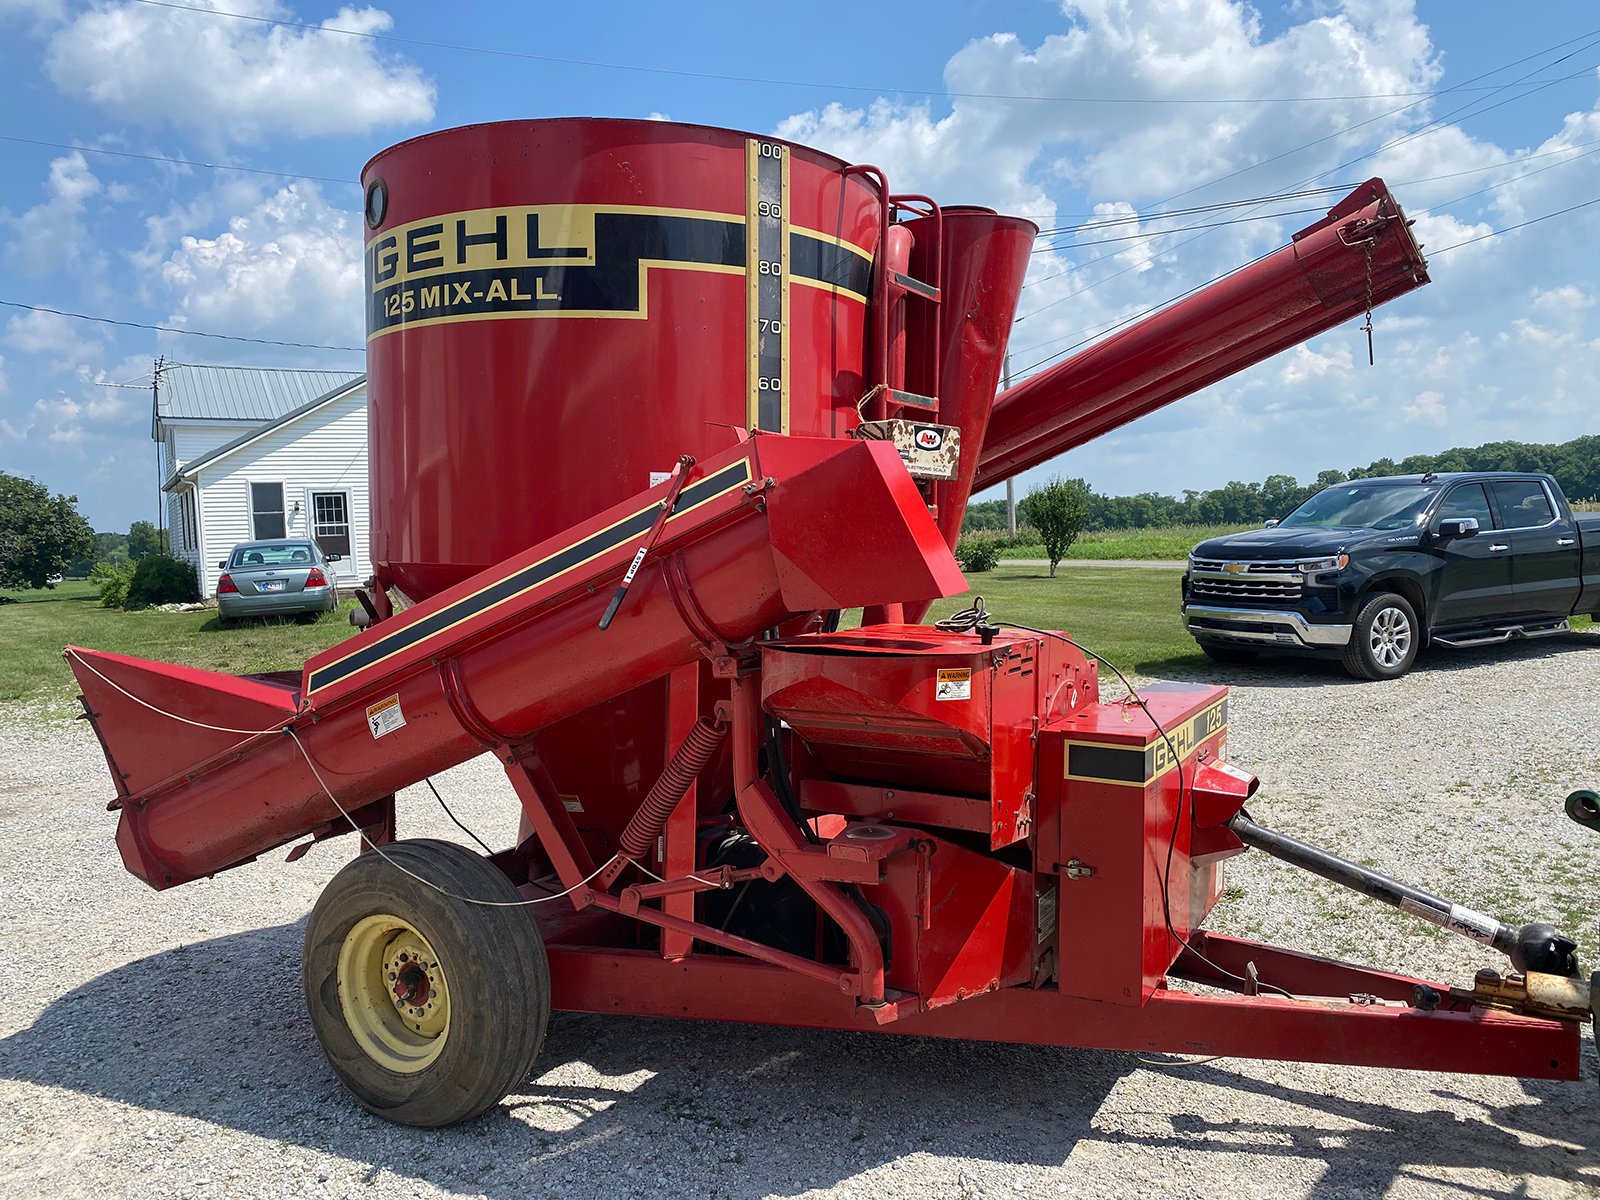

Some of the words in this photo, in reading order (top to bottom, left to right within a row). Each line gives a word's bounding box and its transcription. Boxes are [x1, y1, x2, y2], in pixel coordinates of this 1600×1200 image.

[757, 142, 782, 160] 100
[758, 201, 782, 219] 90
[374, 213, 588, 284] GEHL
[759, 260, 782, 276] 80
[383, 290, 415, 318] 125
[419, 276, 558, 310] MIX-ALL
[759, 318, 782, 334] 70
[758, 376, 781, 391] 60
[906, 464, 932, 472] ELECTRONIC
[630, 555, 642, 575] STOP
[946, 671, 970, 679] WARNING
[1156, 726, 1194, 772] GEHL
[1206, 704, 1222, 734] 125
